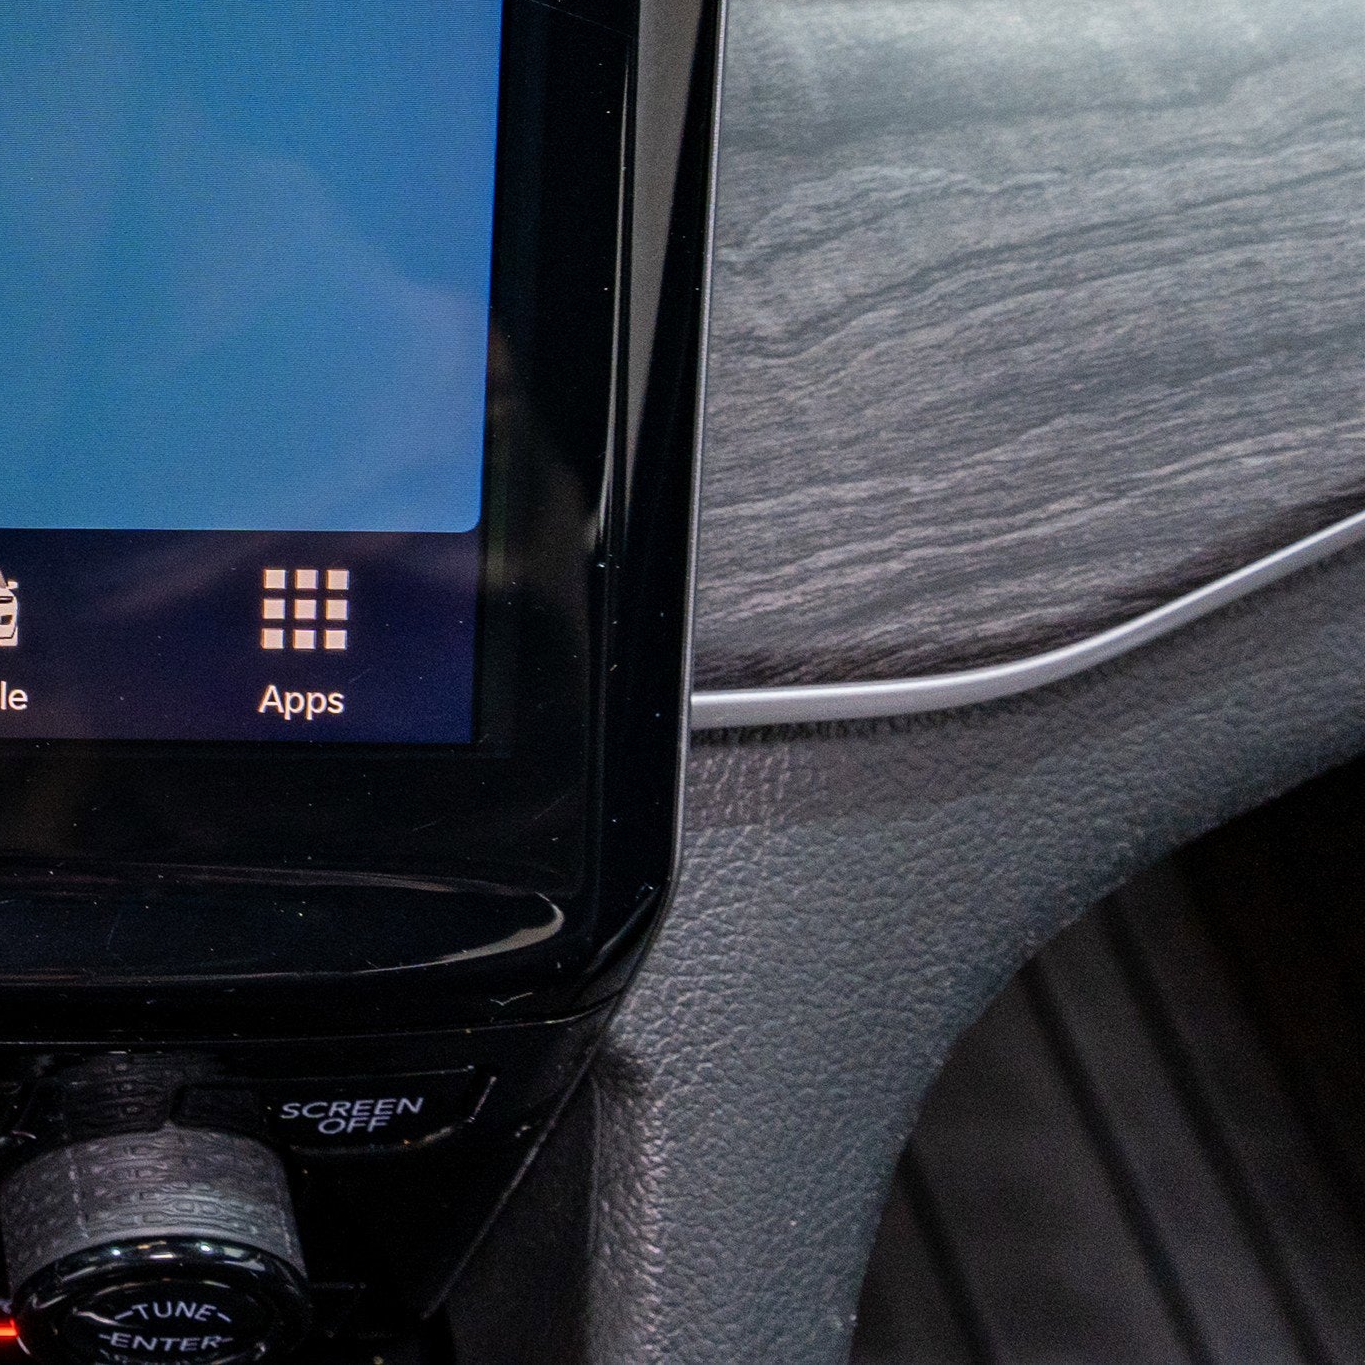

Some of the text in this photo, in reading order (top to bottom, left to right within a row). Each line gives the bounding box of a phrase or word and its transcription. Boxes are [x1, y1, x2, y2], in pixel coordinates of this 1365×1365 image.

[258, 684, 345, 721] Apps
[280, 1097, 424, 1120] SCREEN
[318, 1115, 391, 1135] OFF
[131, 1300, 217, 1322] TUNE
[110, 1331, 220, 1352] ENTER
